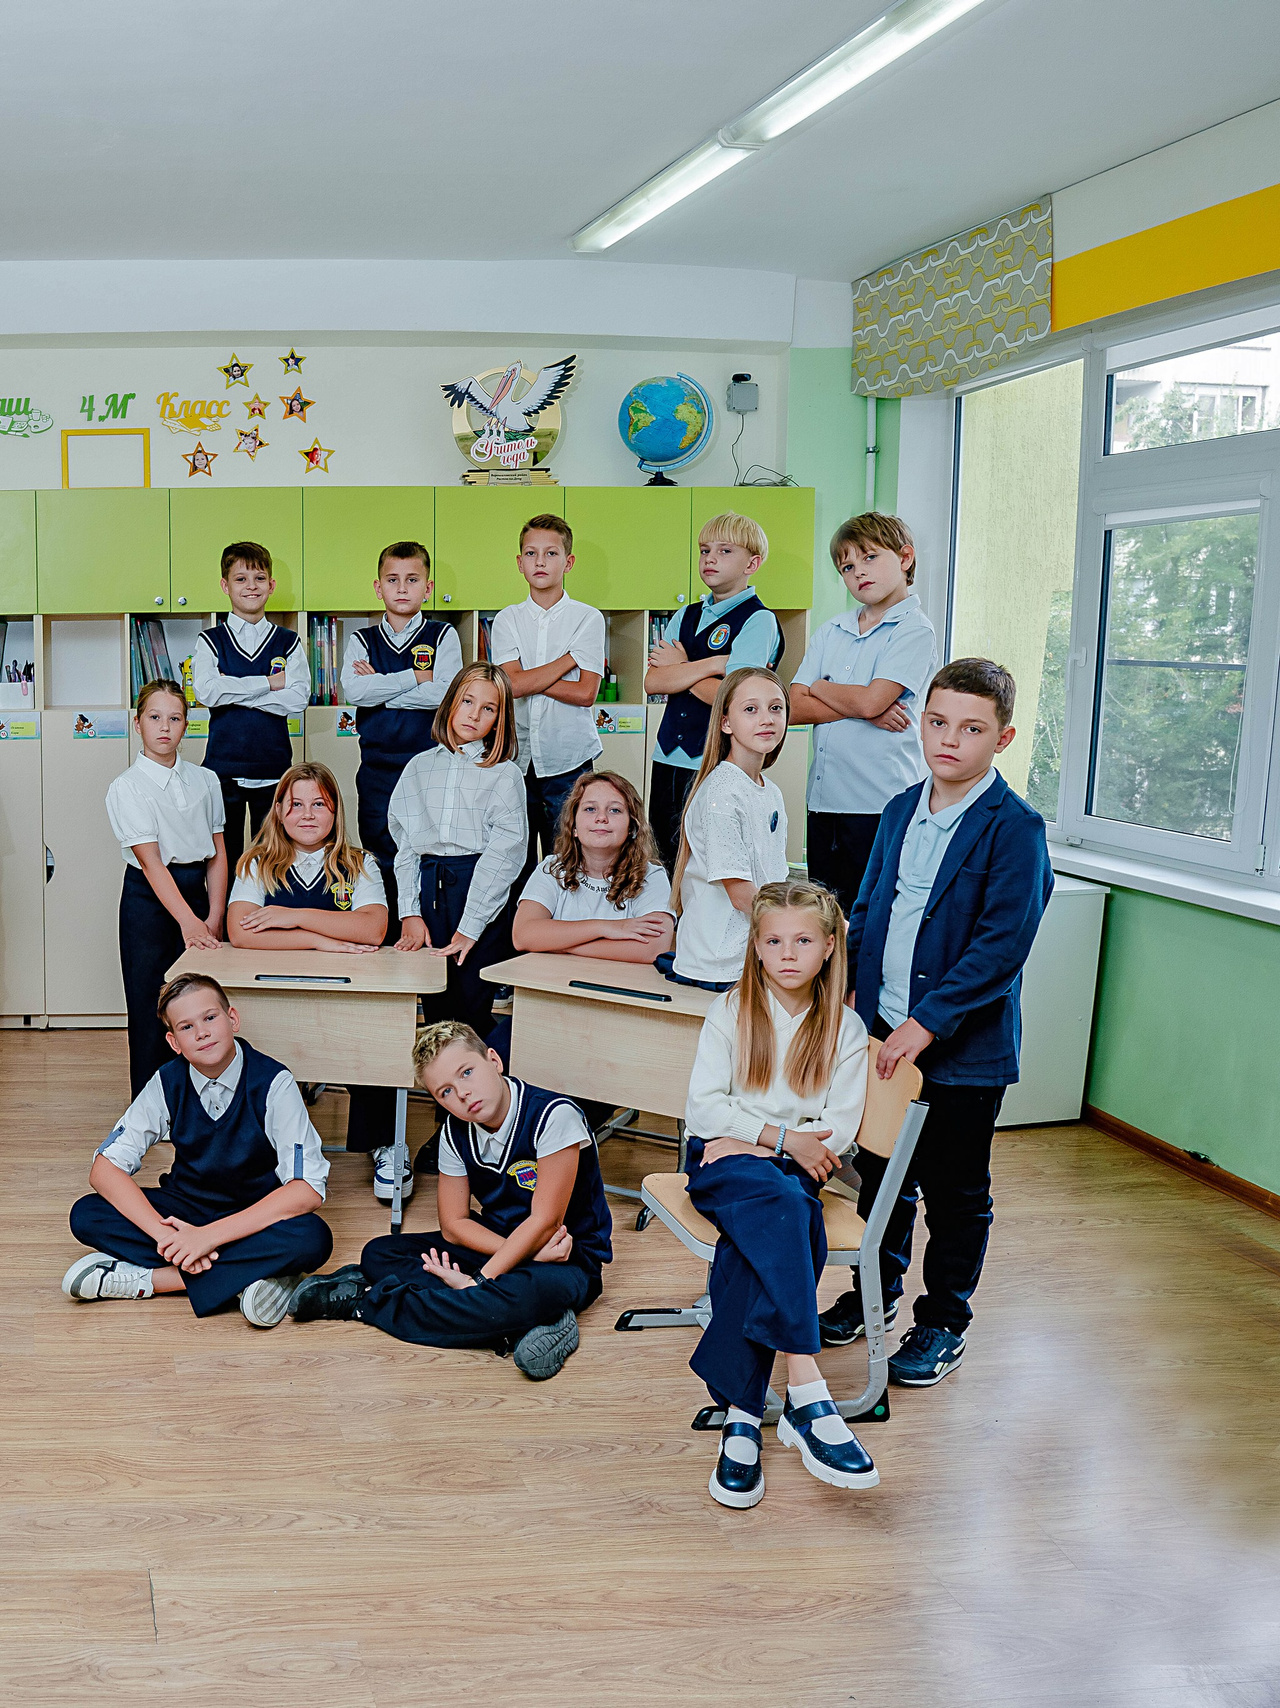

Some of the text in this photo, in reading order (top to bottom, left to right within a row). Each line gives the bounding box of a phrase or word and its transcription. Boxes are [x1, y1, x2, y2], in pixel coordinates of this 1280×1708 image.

[80, 395, 95, 421] 4
[156, 391, 231, 419] Класс
[473, 437, 536, 461] Учитель
[502, 451, 527, 468] года
[520, 1171, 535, 1181] 118
